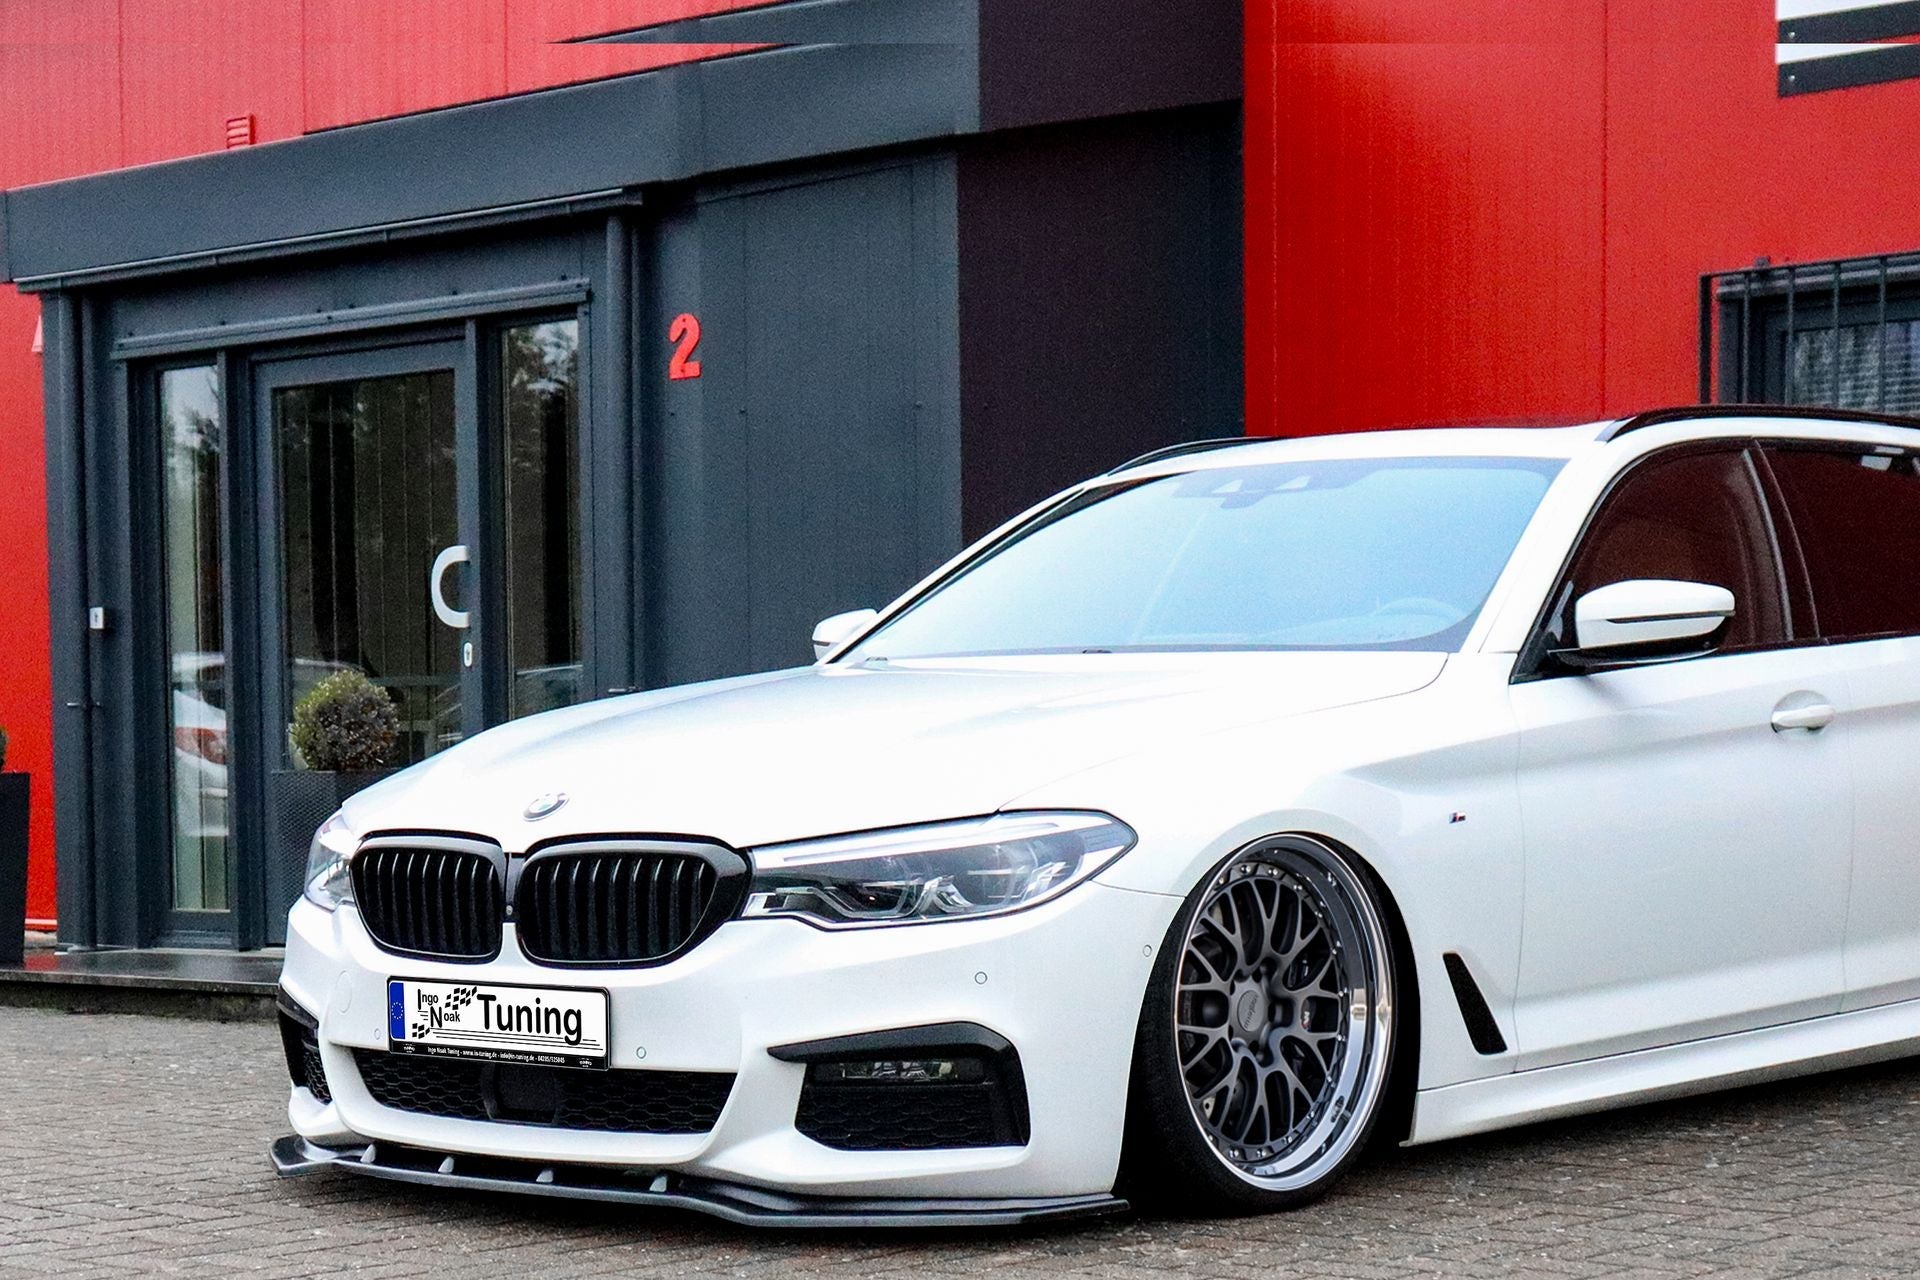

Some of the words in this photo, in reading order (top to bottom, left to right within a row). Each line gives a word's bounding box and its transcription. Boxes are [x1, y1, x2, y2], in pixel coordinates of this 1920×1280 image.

[668, 312, 702, 380] 2
[417, 988, 439, 1010] Ingo
[430, 1006, 461, 1028] Noak
[476, 993, 582, 1046] Tuning
